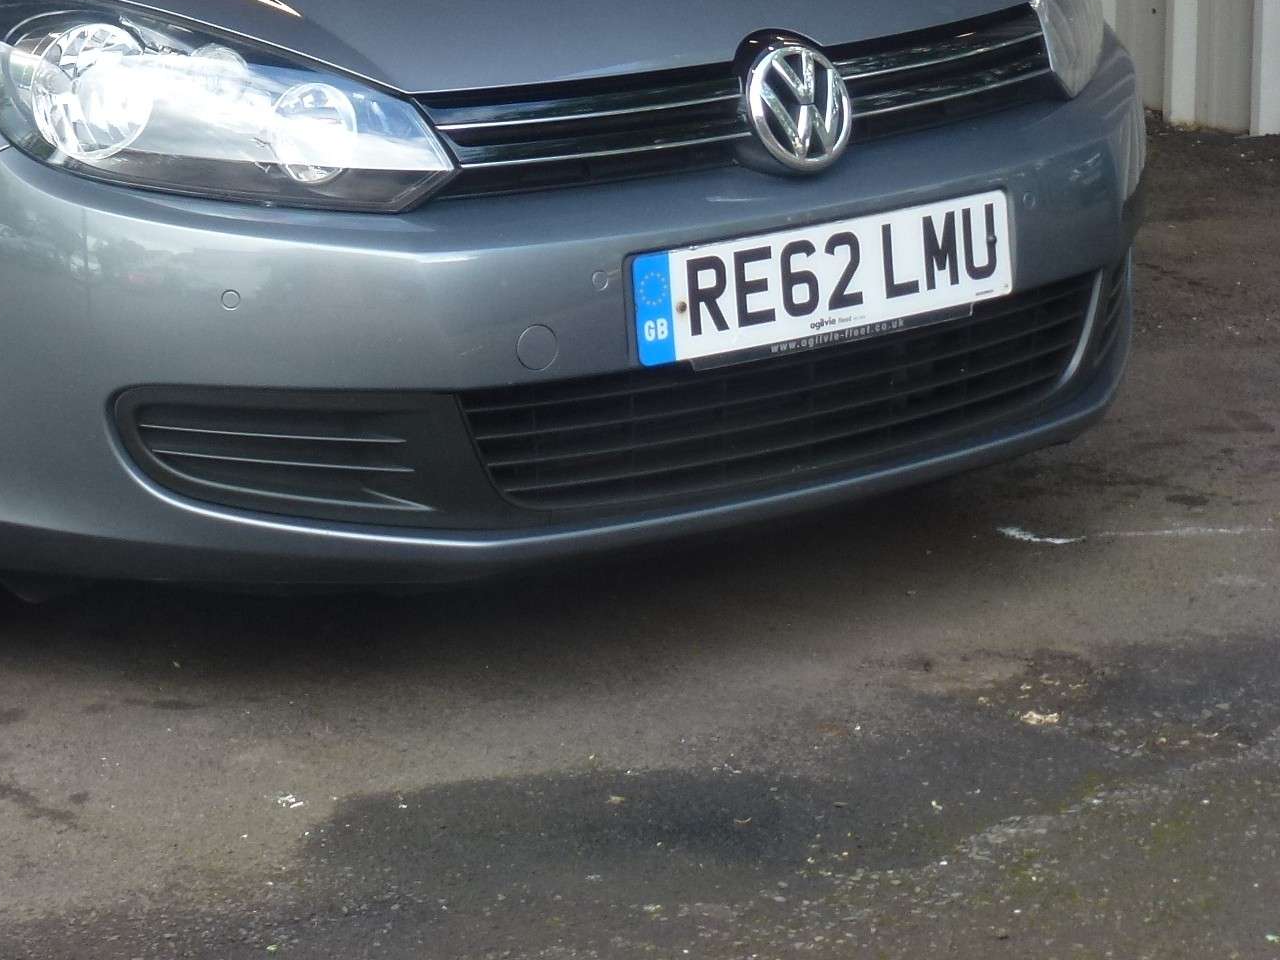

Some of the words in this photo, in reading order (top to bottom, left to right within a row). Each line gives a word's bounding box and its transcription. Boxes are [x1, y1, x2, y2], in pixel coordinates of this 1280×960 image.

[686, 231, 864, 336] RE62
[881, 203, 998, 299] LMU
[644, 318, 668, 342] GB
